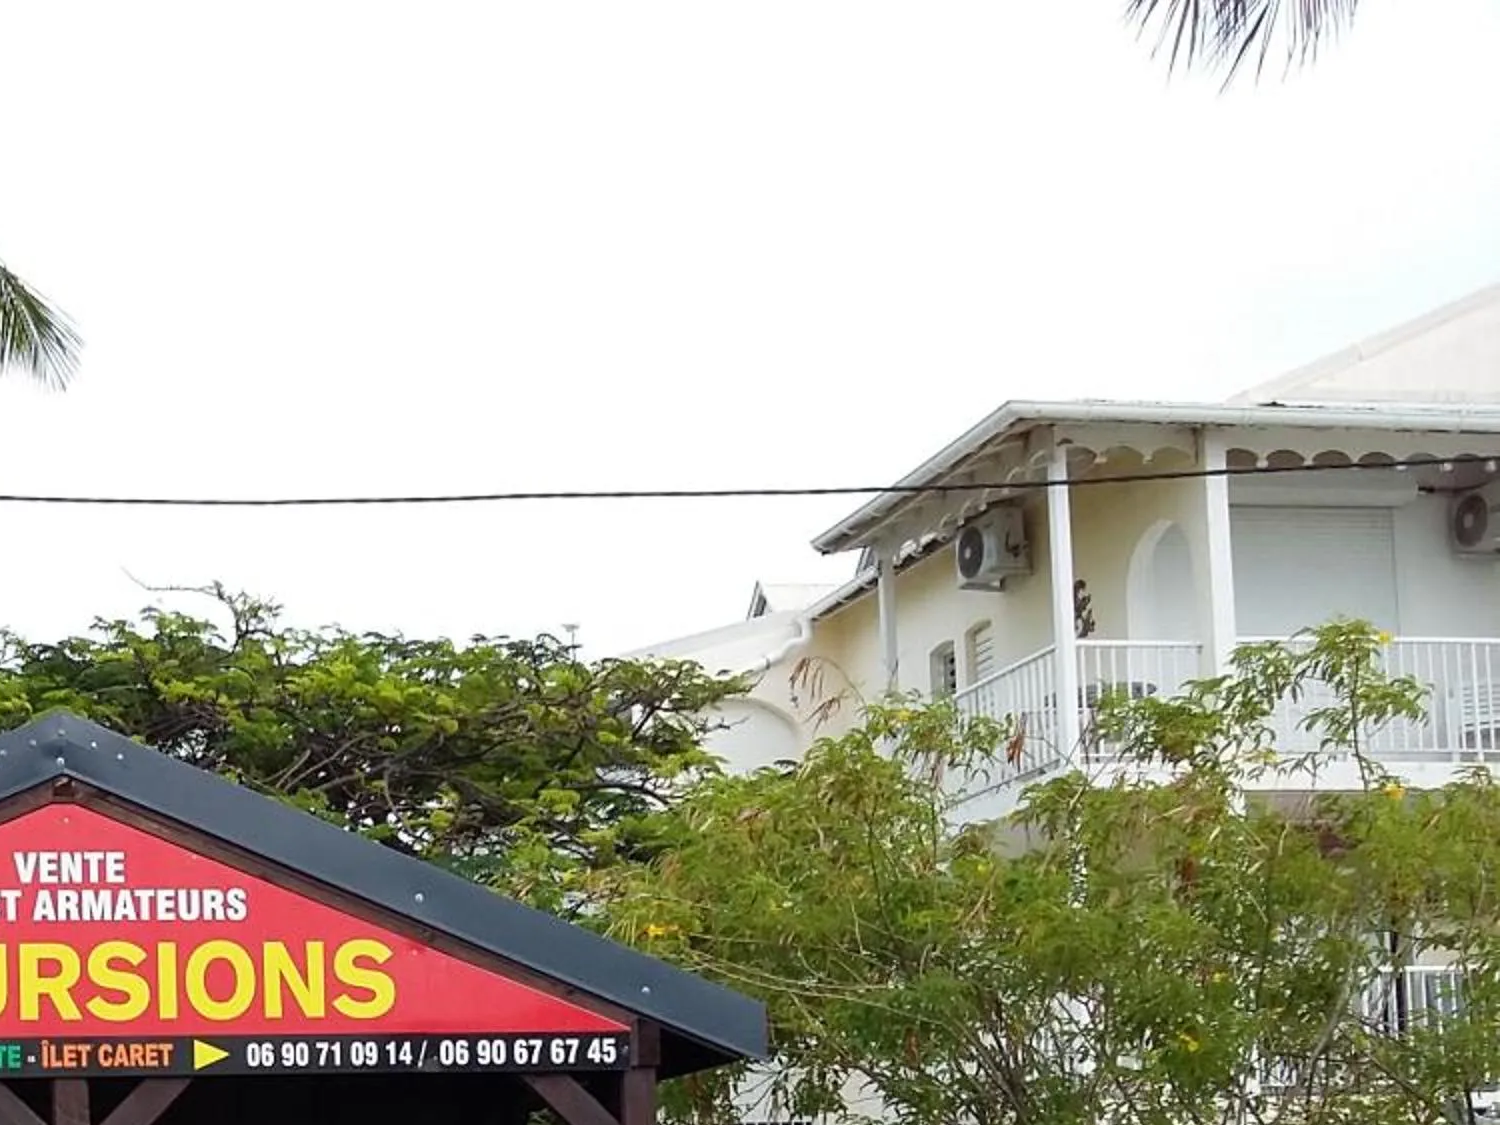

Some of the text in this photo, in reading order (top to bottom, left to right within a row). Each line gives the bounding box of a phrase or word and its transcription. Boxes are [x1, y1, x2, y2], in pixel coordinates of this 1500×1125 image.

[14, 850, 126, 884] VENTE
[33, 887, 248, 921] ARMATEURS
[41, 1040, 91, 1069] ÎLET
[98, 1043, 174, 1068] CARET
[246, 1043, 274, 1067] 06
[281, 1042, 309, 1067] 90
[315, 1041, 341, 1066] 71
[350, 1041, 378, 1066] 09
[439, 1040, 469, 1065] 06
[477, 1040, 506, 1065] 90
[513, 1039, 543, 1065] 67
[550, 1039, 579, 1064] 67
[587, 1038, 617, 1064] 45
